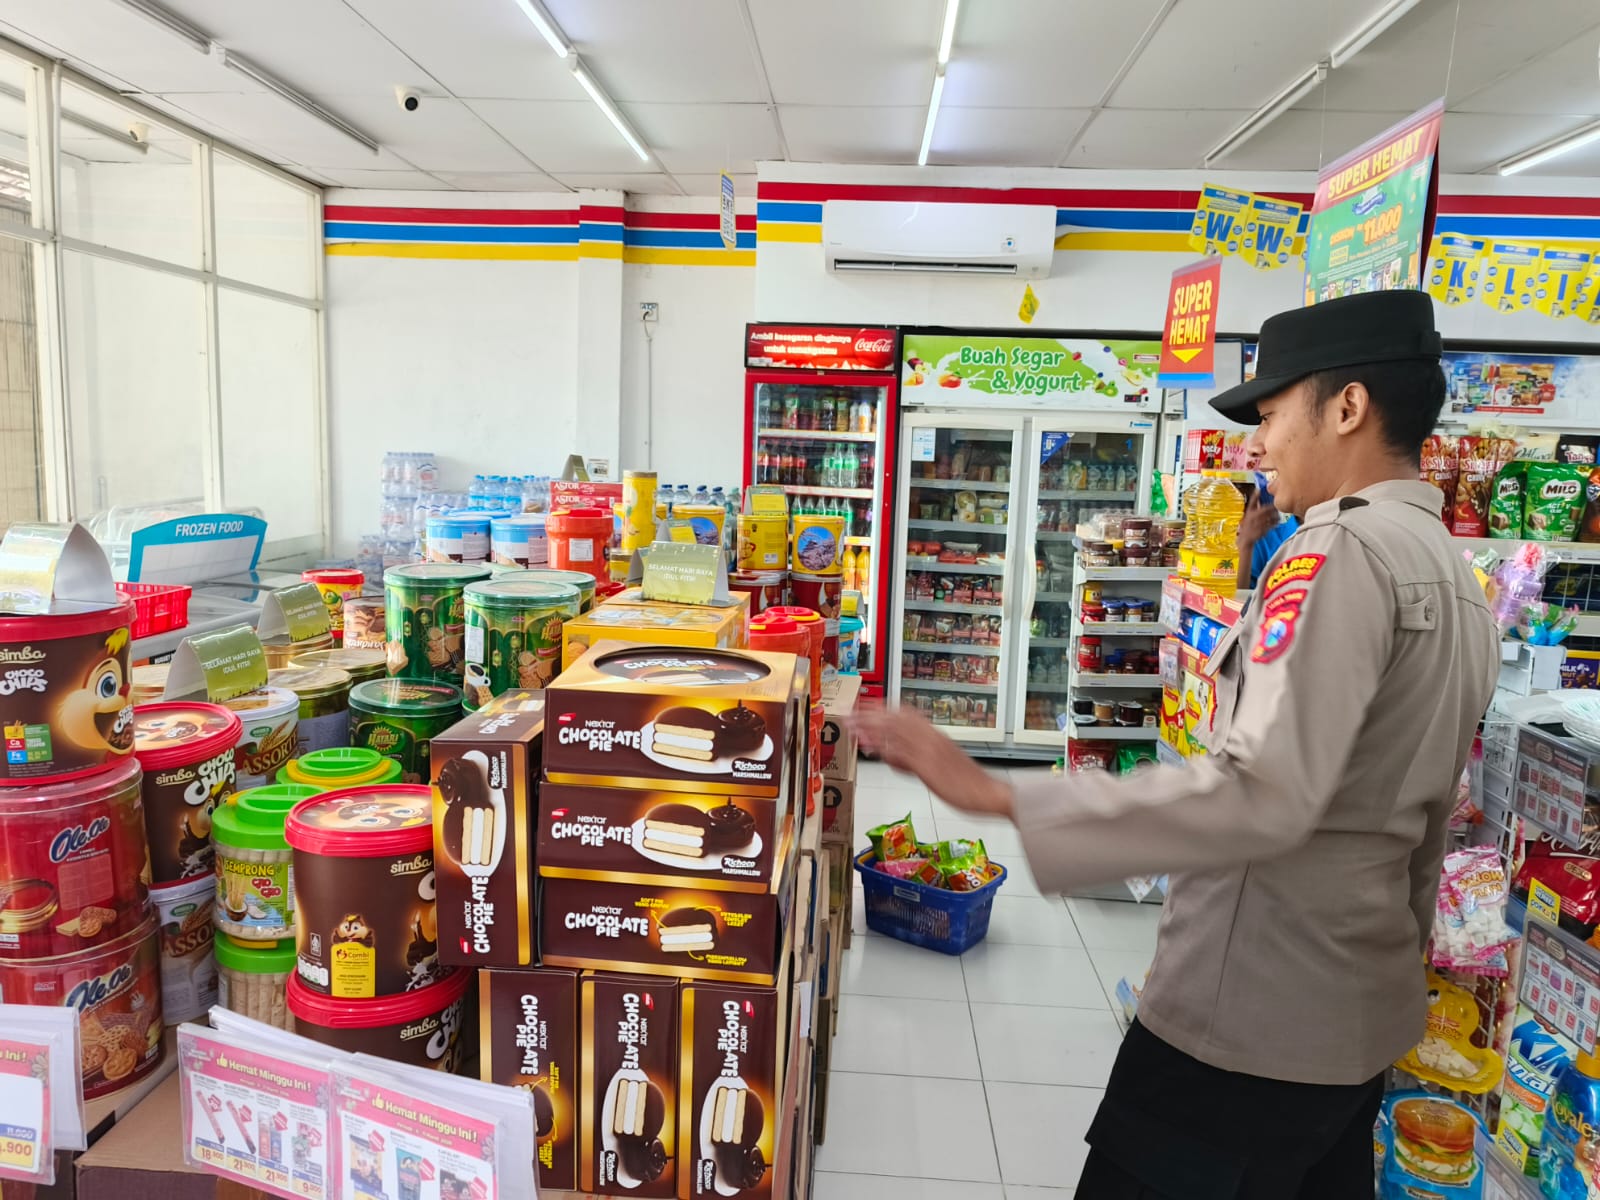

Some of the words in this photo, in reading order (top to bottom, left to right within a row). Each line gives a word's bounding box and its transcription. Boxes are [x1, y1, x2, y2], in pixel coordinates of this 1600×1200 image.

[1328, 158, 1370, 198] SUPER
[1372, 129, 1424, 178] HEMAT
[1206, 212, 1234, 241] W
[1255, 223, 1284, 253] W
[1450, 260, 1467, 288] K
[1504, 268, 1515, 294] L
[1557, 274, 1568, 300] I
[1173, 280, 1212, 316] SUPER
[1169, 314, 1210, 345] HEMAT
[960, 347, 1005, 365] Buah
[1011, 347, 1065, 371] Segar
[992, 371, 1009, 390] &
[1014, 371, 1082, 395] Yogurt
[555, 496, 580, 504] ASTOR
[1546, 485, 1576, 494] MILO
[176, 522, 216, 537] FROZEN
[218, 521, 243, 534] FOOD
[0, 646, 46, 662] simba
[5, 669, 44, 678] CHOCO
[0, 678, 48, 695] CHIPS
[368, 733, 399, 745] HATARI
[559, 727, 641, 749] CHOCOLATE
[589, 740, 612, 752] PIE
[198, 748, 235, 776] CHOCO
[156, 768, 195, 785] simba
[184, 761, 236, 805] CHIPS
[551, 822, 632, 845] CHOCOLATE
[581, 836, 604, 847] PIE
[390, 855, 432, 875] simba
[472, 875, 491, 953] CHOCOLATE
[484, 903, 494, 925] PIE
[565, 912, 648, 936] CHOCOLATE
[167, 925, 214, 957] ASSO
[595, 926, 619, 937] PIE
[400, 1018, 439, 1039] simba
[516, 1024, 527, 1047] PIE
[521, 994, 539, 1075] CHOCOLATE
[618, 1021, 629, 1043] PIE
[622, 993, 640, 1070] CHOCOLATE
[718, 1028, 728, 1051] PIE
[721, 1000, 739, 1077] CHOCOLATE
[229, 1059, 258, 1077] Hemat
[259, 1068, 293, 1087] Minggu
[385, 1101, 417, 1121] Hemat
[419, 1113, 457, 1136] Minggu
